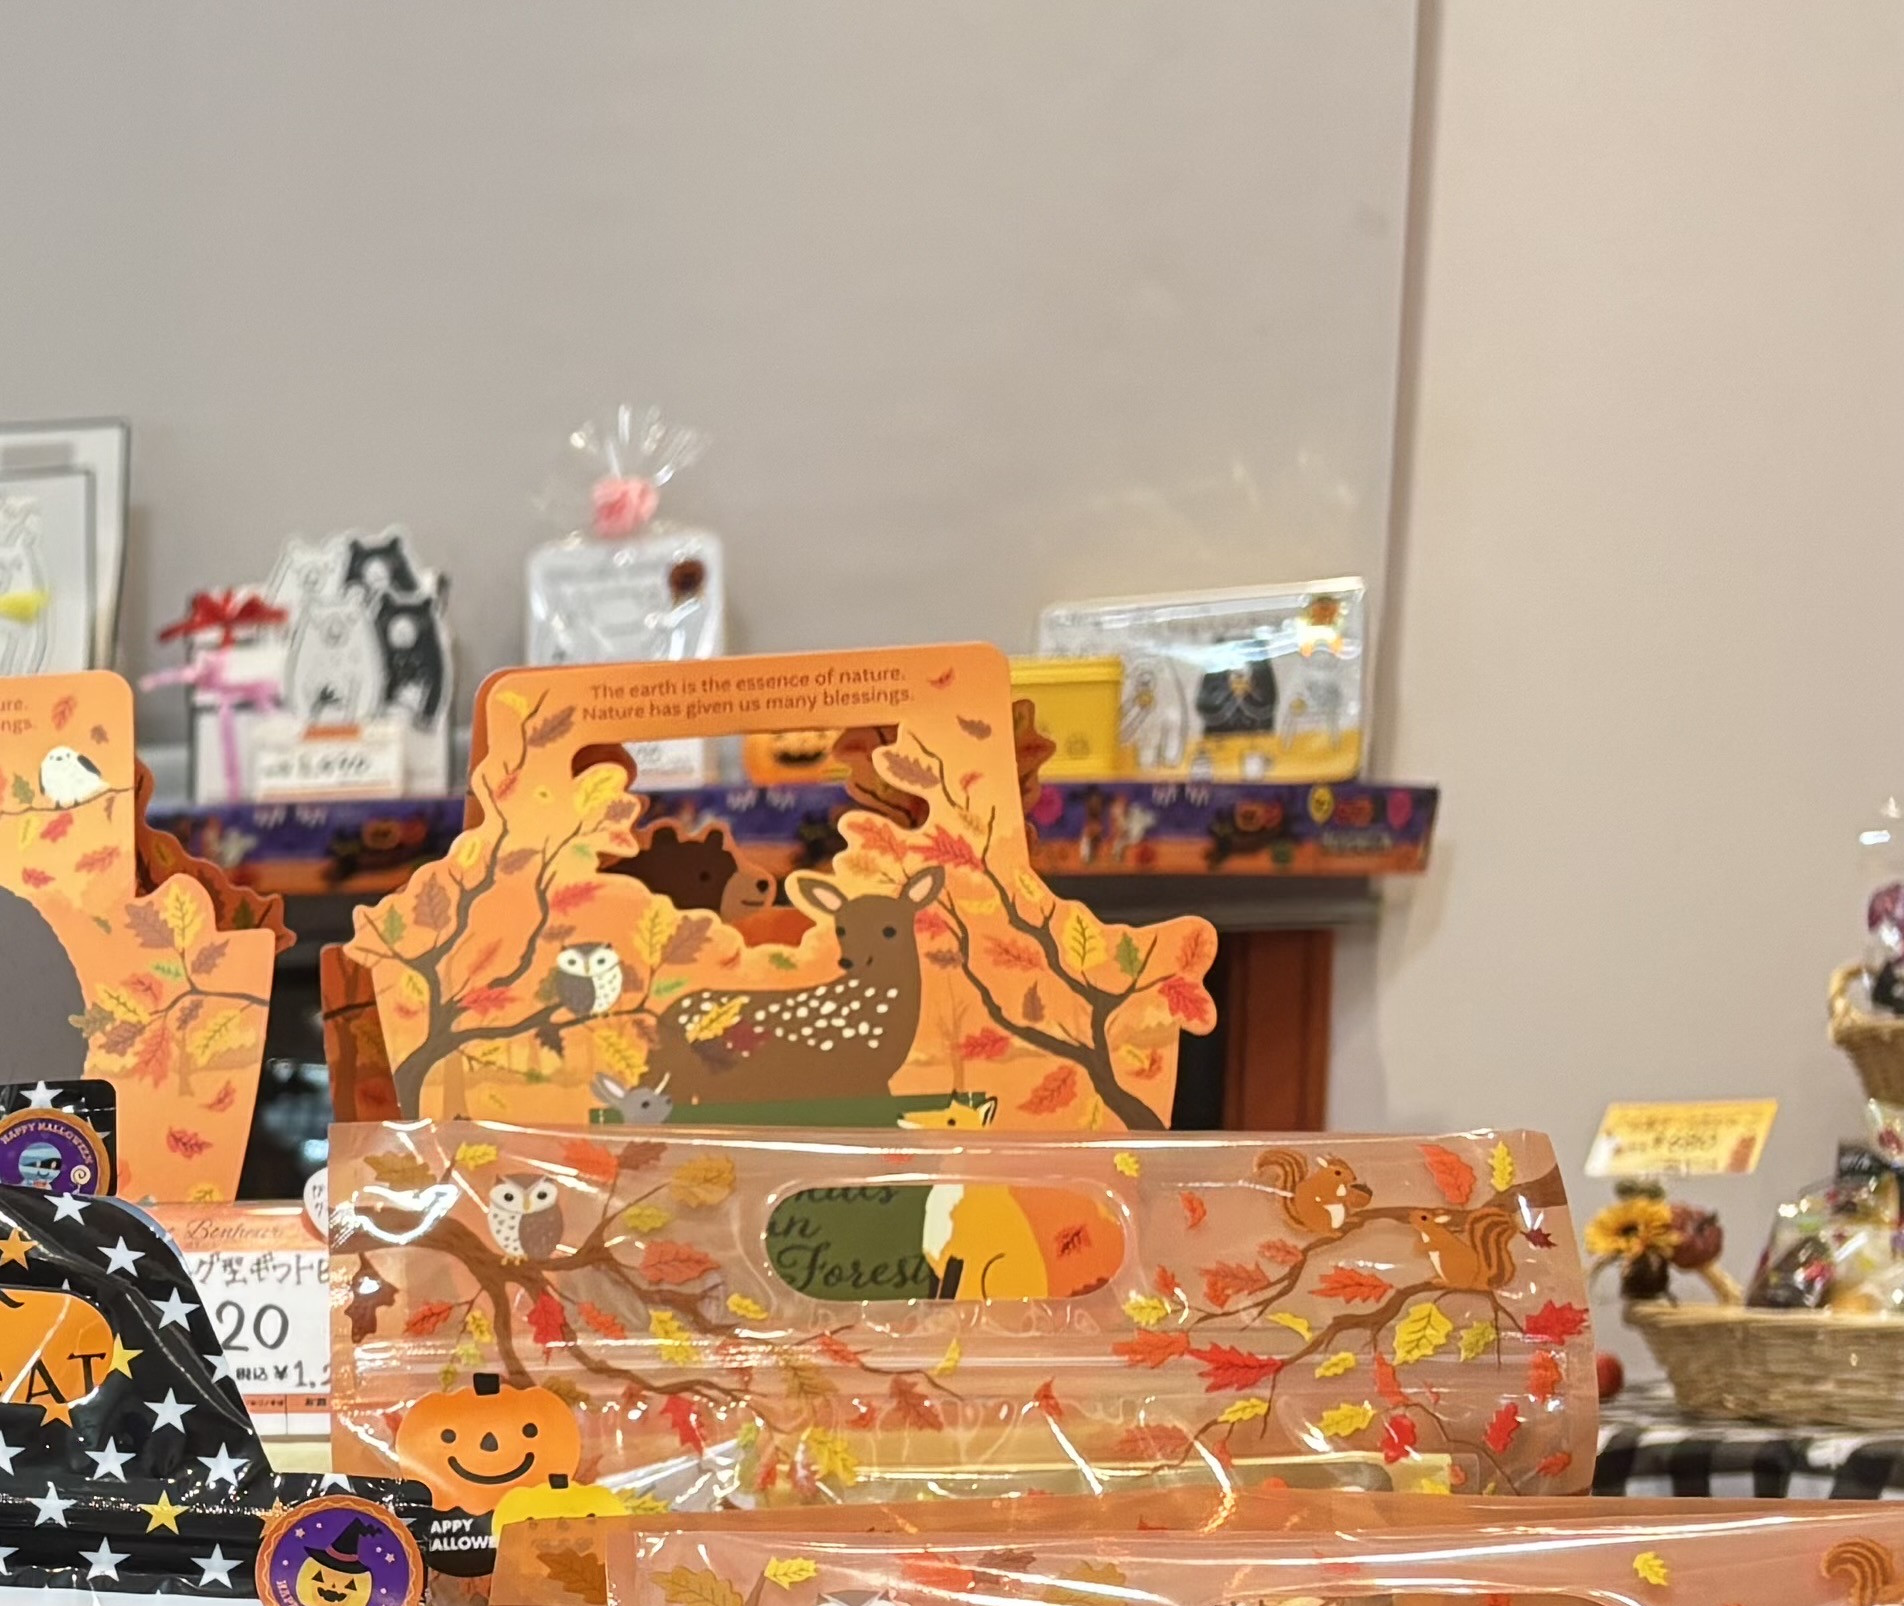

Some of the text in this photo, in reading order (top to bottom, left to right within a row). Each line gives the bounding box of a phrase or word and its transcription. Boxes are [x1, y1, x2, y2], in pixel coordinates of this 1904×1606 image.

[591, 667, 907, 700] The earth is the essence of nature.
[582, 686, 914, 721] Nature has given us many blessings.
